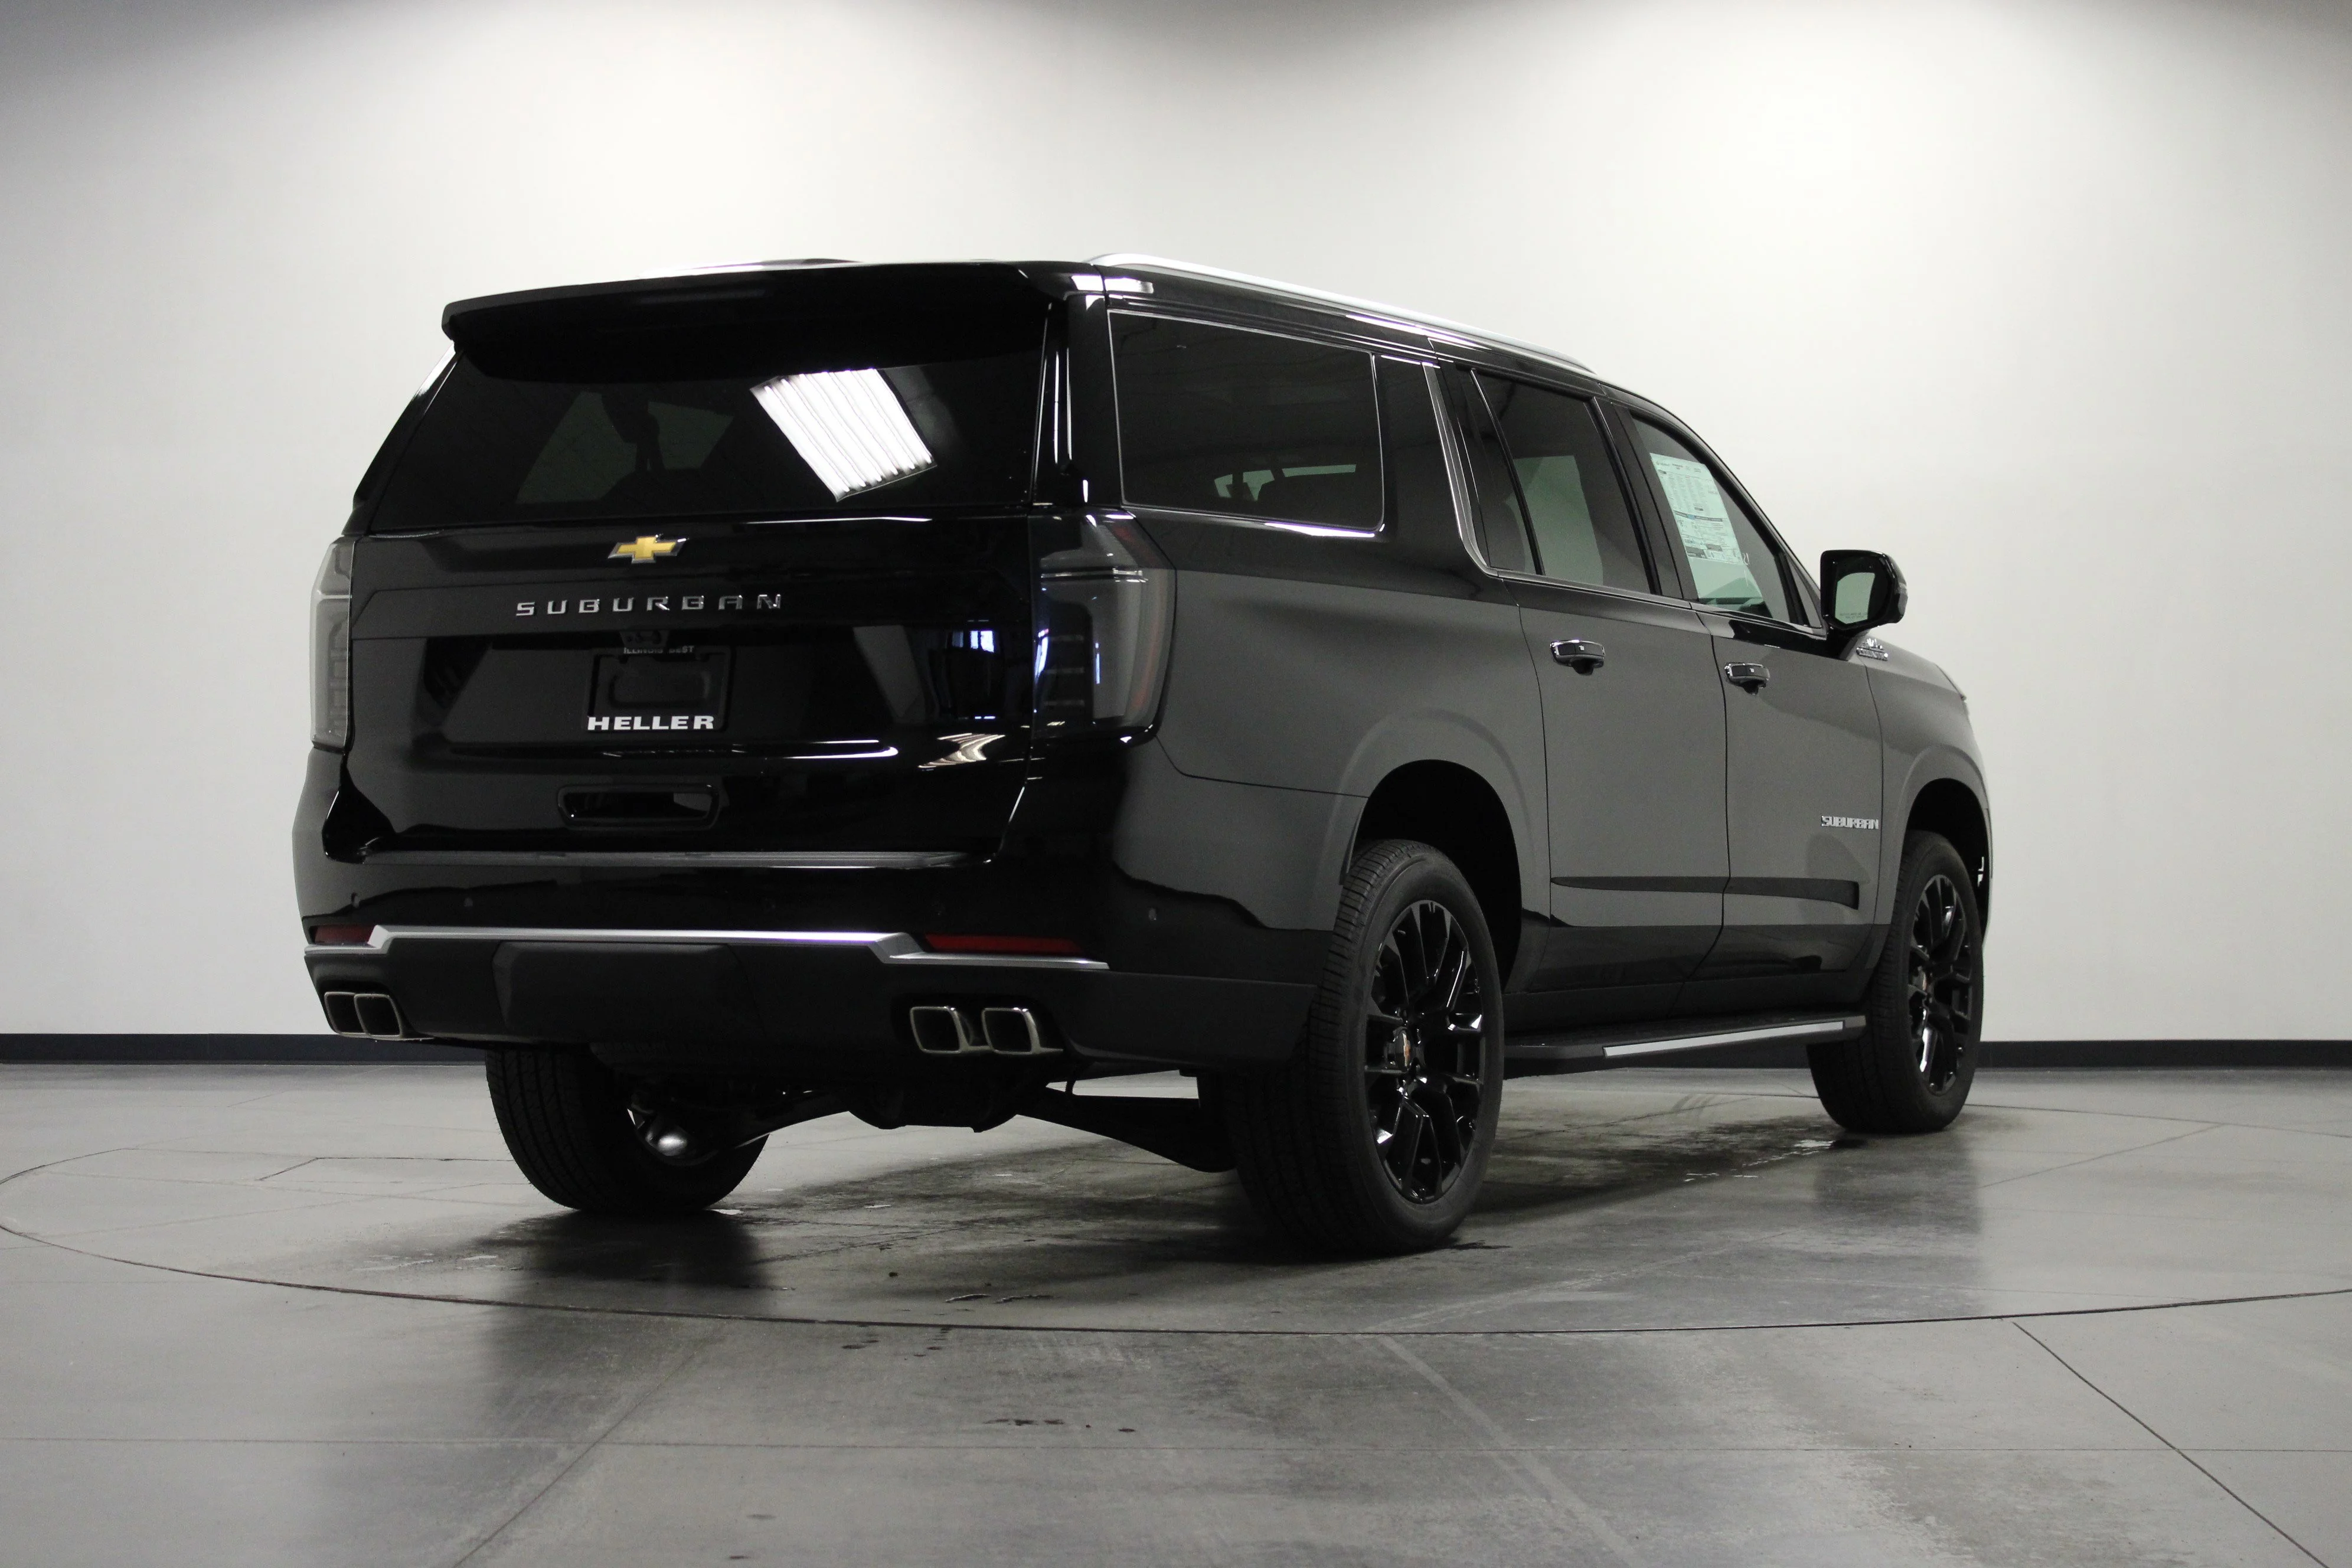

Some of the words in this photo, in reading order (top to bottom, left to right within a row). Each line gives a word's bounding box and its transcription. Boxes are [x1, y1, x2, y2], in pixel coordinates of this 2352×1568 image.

[516, 594, 781, 616] SUBURBAN
[587, 716, 714, 731] HELLER
[1821, 815, 1879, 829] SUBURBAN
